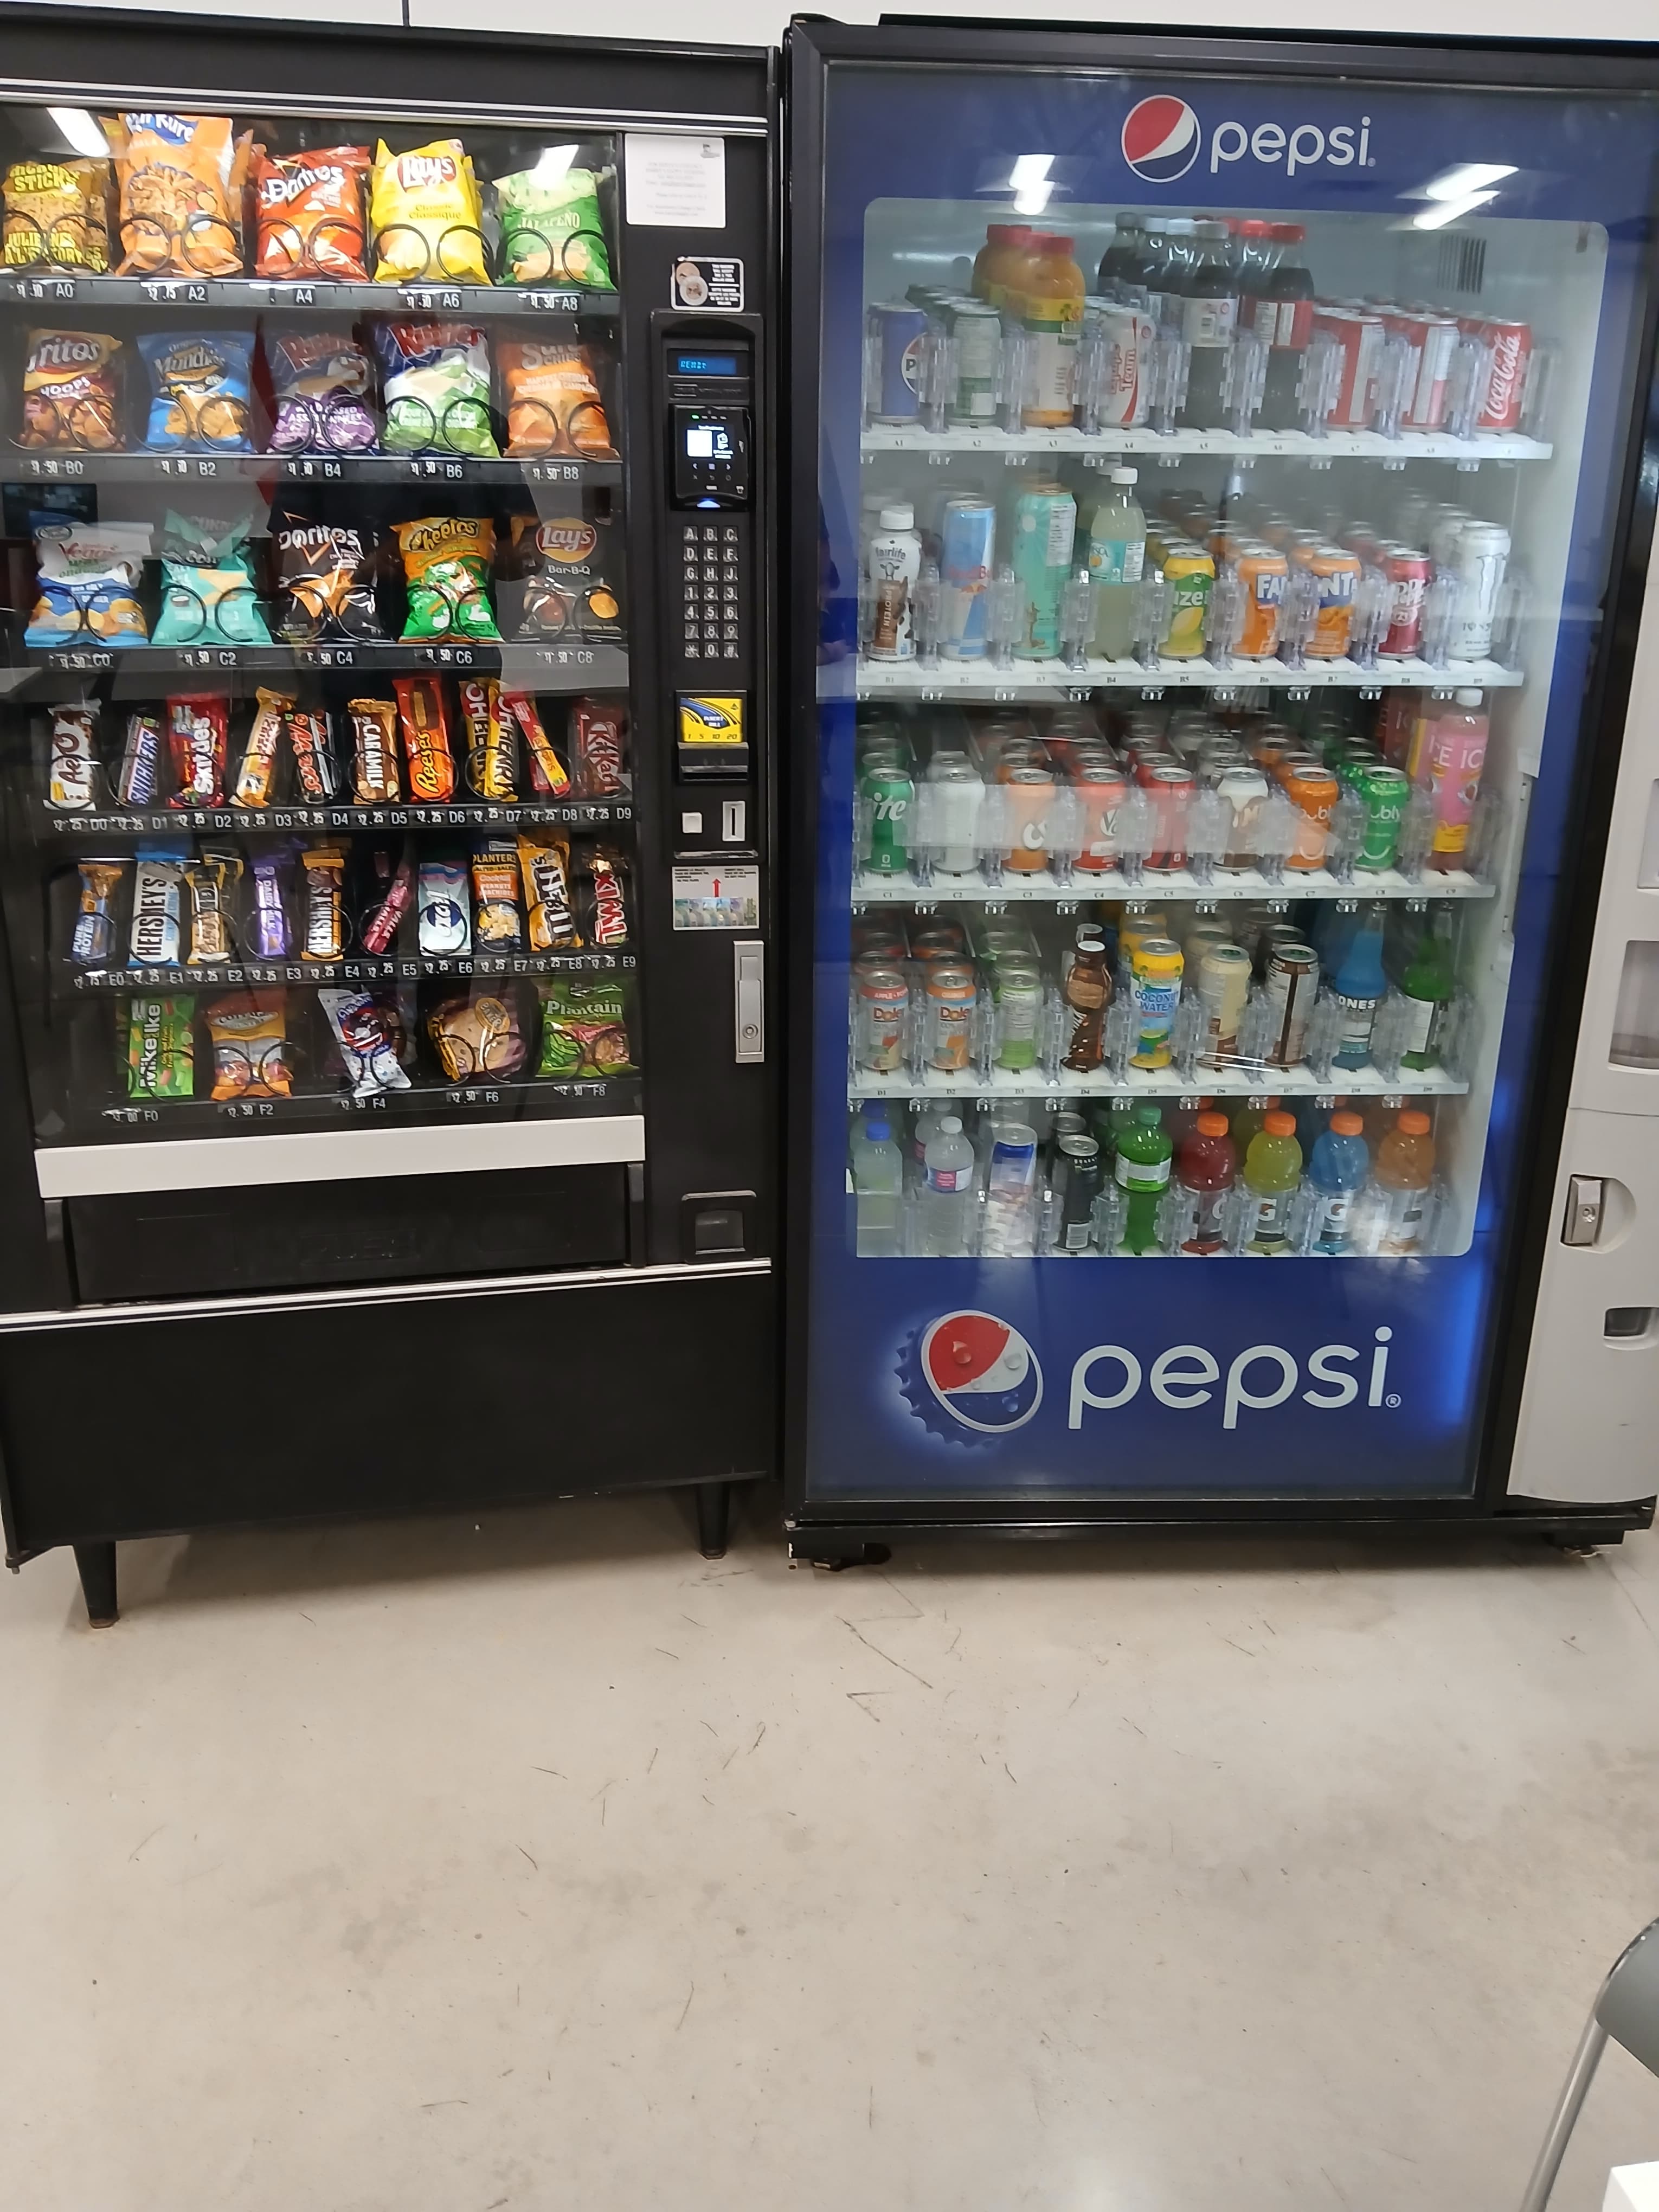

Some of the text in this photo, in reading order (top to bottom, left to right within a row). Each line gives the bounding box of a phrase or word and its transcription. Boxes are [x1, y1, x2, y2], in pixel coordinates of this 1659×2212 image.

[1211, 116, 1371, 176] pepsi
[266, 165, 344, 203] Doritos
[408, 210, 462, 221] Classique
[56, 282, 75, 299] A0
[188, 286, 206, 302] A2
[295, 290, 312, 304] A4
[443, 294, 460, 308] A6
[561, 297, 578, 312] A8
[66, 460, 83, 475] B0
[199, 461, 216, 477] B2
[325, 463, 342, 477] B4
[447, 465, 463, 479] B6
[563, 466, 579, 480] B8
[279, 525, 359, 551] Doritos
[686, 528, 734, 540] A B C
[687, 548, 734, 560] D E F
[876, 547, 906, 561] fairlife
[548, 564, 590, 576] Bar-B-Q
[687, 567, 734, 578] G H J
[688, 587, 734, 599] 1 2 3
[687, 606, 734, 618] 4 5 6
[883, 590, 893, 627] PROTEIN
[689, 625, 735, 636] 7 8 9
[708, 644, 715, 655] 0
[219, 652, 236, 666] C2
[336, 651, 353, 665] C4
[456, 651, 473, 665] C6
[577, 651, 594, 665] C8
[466, 683, 488, 720] OH
[288, 724, 324, 794] Mars
[364, 723, 385, 789] CARAMILK
[417, 730, 441, 794] Reese's
[130, 730, 160, 806] SNICKERS
[332, 813, 349, 825] D4
[391, 812, 407, 825] D5
[449, 811, 465, 823] D6
[506, 810, 520, 822] D7
[562, 808, 577, 821] D8
[616, 807, 632, 819] D9
[152, 817, 168, 829] D1
[216, 815, 232, 828] D2
[275, 814, 292, 827] D3
[472, 853, 517, 864] PLANTERS
[594, 873, 627, 944] TWIX
[136, 877, 168, 956] HERSHEY'S
[307, 886, 333, 954] HERSHEY'S
[459, 962, 473, 974] E6
[514, 960, 529, 972] E7
[569, 957, 583, 969] E8
[623, 956, 636, 968] E9
[228, 970, 243, 982] E2
[286, 967, 301, 980] E3
[345, 966, 360, 978] E4
[402, 963, 417, 976] E5
[109, 974, 124, 987] E0
[169, 972, 184, 984] E1
[546, 999, 623, 1015] Plantain
[1140, 1000, 1174, 1012] WATER
[874, 1006, 904, 1022] Dole
[940, 1006, 971, 1021] Dole
[139, 1004, 162, 1088] Mike Ike
[486, 1091, 499, 1103] F6
[593, 1084, 606, 1097] F8
[260, 1103, 274, 1115] F2
[373, 1096, 386, 1109] F4
[144, 1109, 159, 1122] F0
[1068, 1326, 1393, 1430] pepsi
